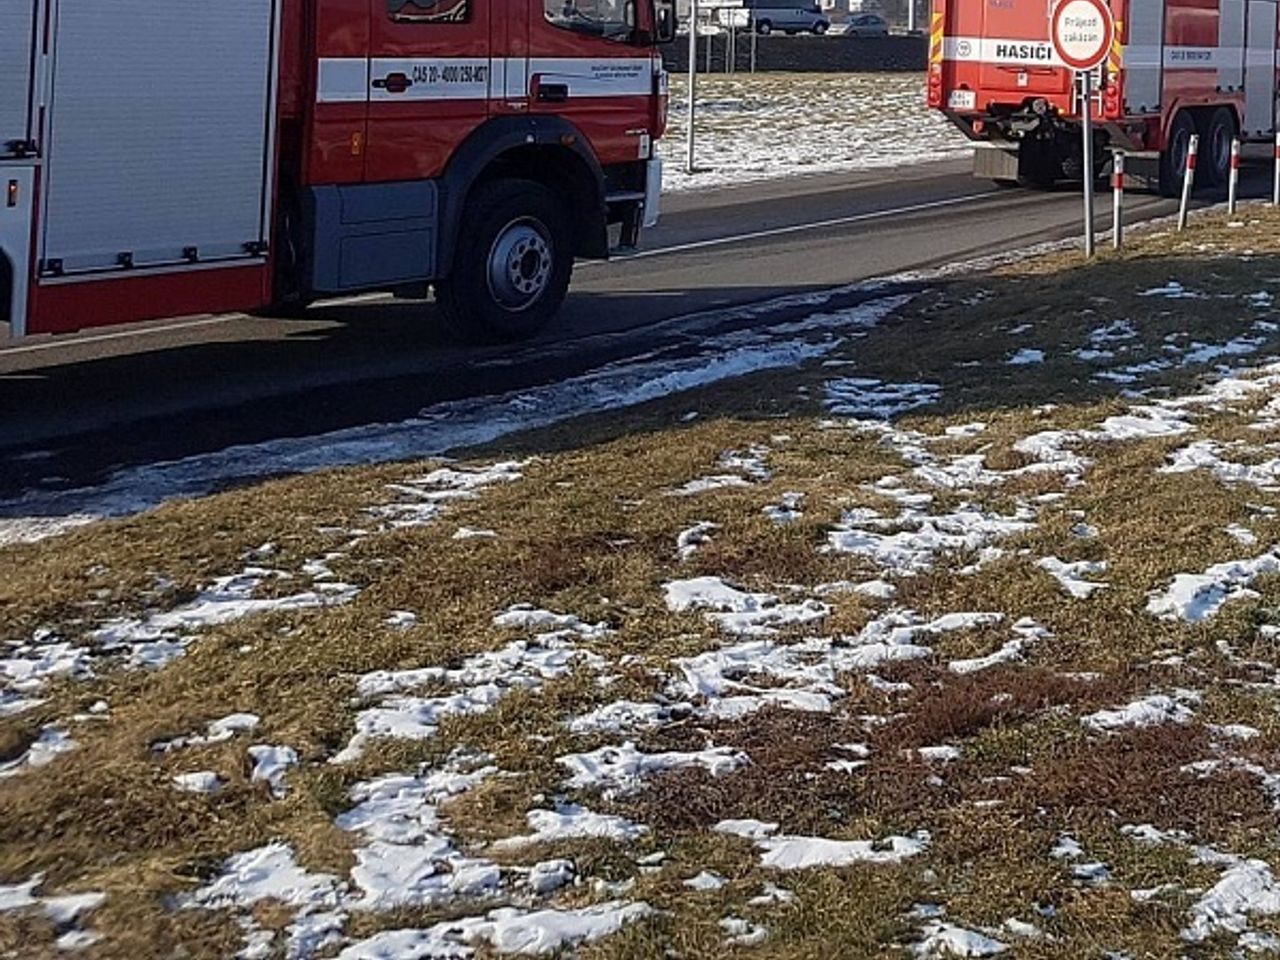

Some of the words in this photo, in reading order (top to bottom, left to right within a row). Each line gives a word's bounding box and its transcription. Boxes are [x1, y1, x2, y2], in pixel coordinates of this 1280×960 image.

[1064, 17, 1097, 29] Průjezd
[1064, 32, 1098, 42] zakázán
[996, 43, 1052, 60] HASIČI
